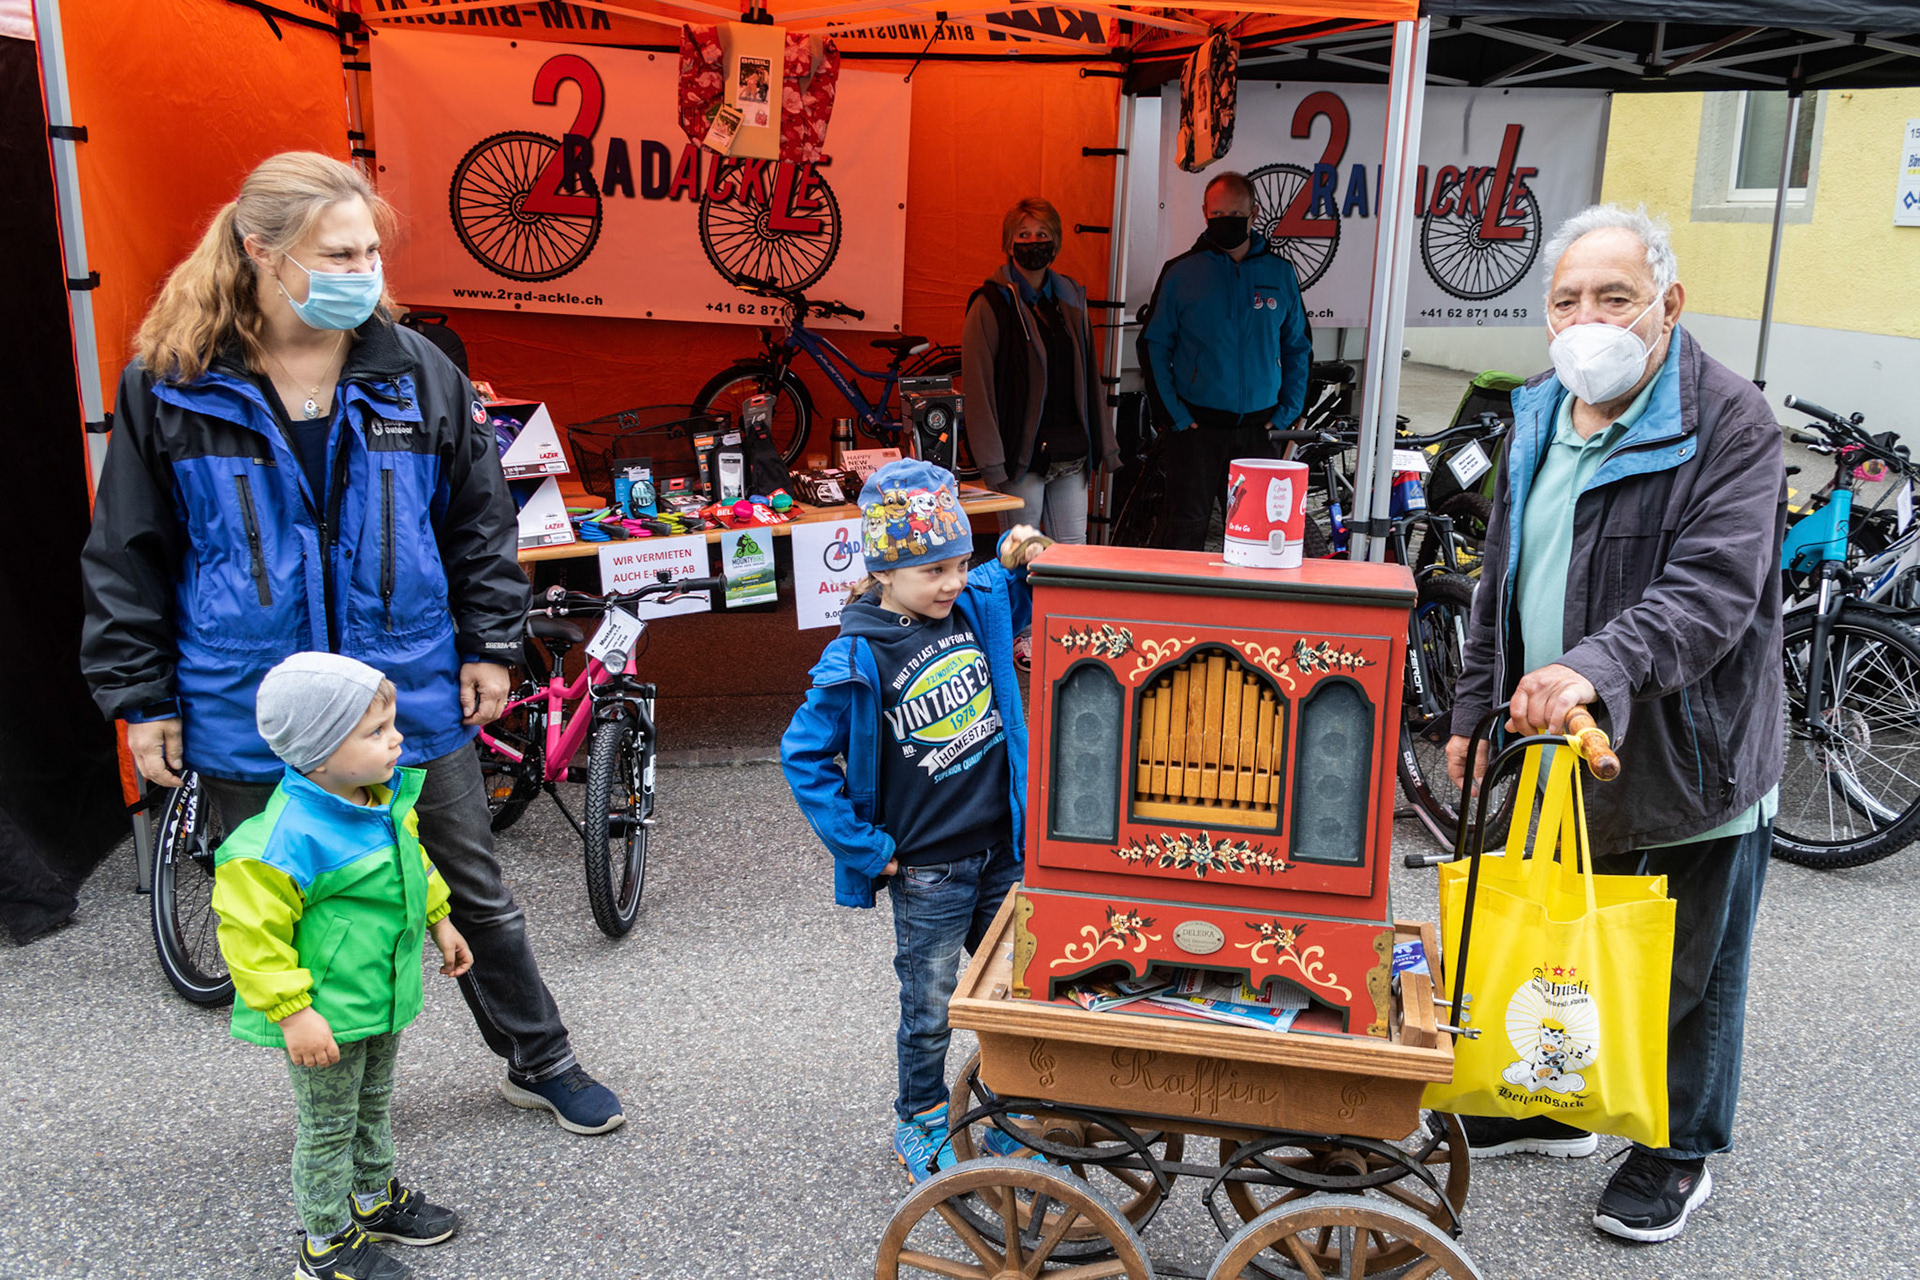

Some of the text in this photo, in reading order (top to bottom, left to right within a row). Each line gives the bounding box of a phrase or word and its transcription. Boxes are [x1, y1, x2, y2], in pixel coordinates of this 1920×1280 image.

[452, 287, 603, 306] www.2rad-ackle.ch
[706, 302, 785, 316] +41 62 871
[1420, 308, 1527, 318] +41 62 871 04 53
[544, 522, 565, 531] LAZER
[613, 548, 692, 566] WIR VERMIETEN
[613, 571, 641, 583] AUCH
[681, 564, 695, 574] AB
[599, 623, 617, 646] Mustang
[892, 667, 911, 691] BUILT
[907, 658, 920, 671] TO
[917, 645, 938, 662] LAST,
[883, 666, 978, 741] VINTAGE
[949, 704, 976, 731] 1978
[938, 719, 996, 765] HOMESTATE
[934, 763, 963, 784] SUPERIOR
[1182, 929, 1215, 938] DELEIKA
[1110, 1046, 1279, 1116] Raffin
